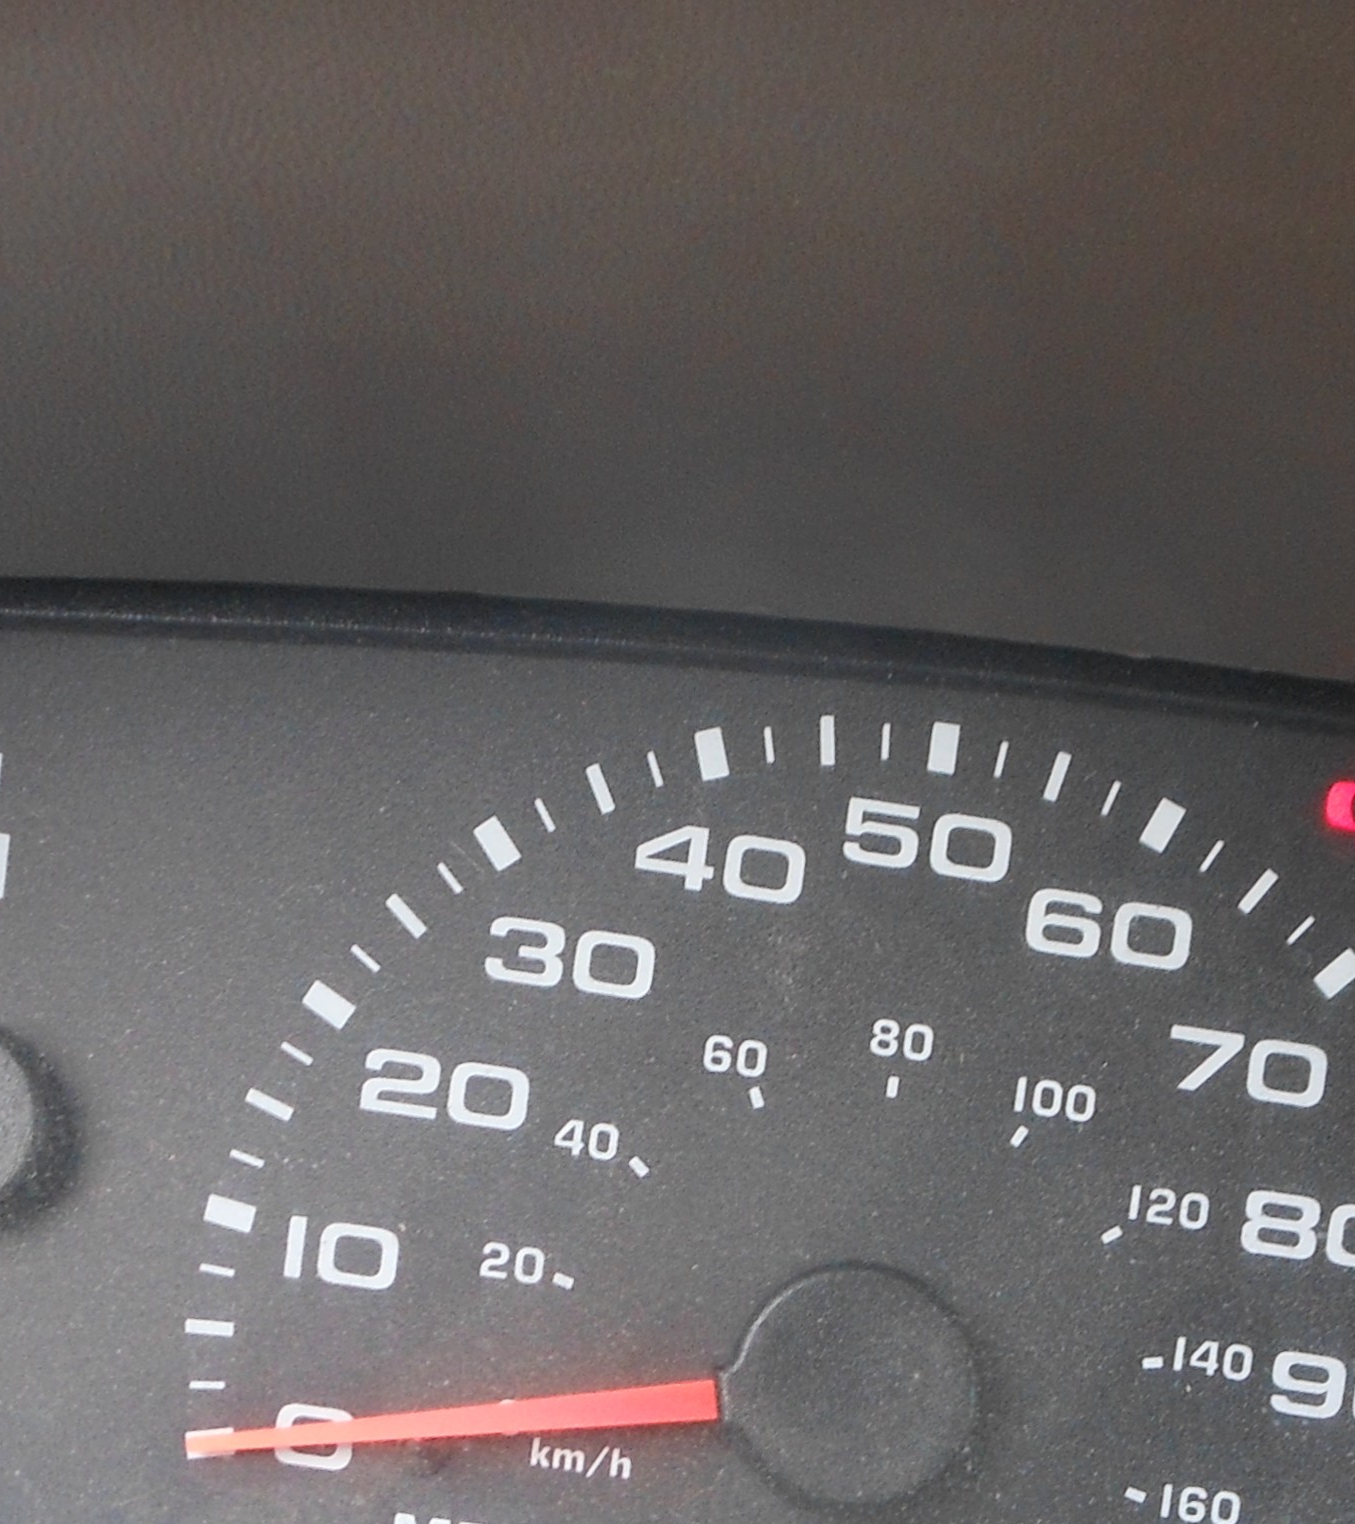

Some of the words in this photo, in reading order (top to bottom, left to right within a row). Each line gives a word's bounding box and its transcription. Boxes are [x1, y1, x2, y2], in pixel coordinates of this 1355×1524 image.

[842, 797, 1013, 883] 50
[634, 825, 806, 904] 40
[1025, 888, 1193, 971] 60
[484, 916, 656, 1000] 30
[703, 1034, 768, 1078] 60
[869, 1018, 934, 1062] 80
[359, 1048, 530, 1131] 20
[1170, 1024, 1328, 1108] 70
[1013, 1076, 1096, 1123] 100
[554, 1119, 620, 1161] 40
[1128, 1184, 1210, 1230] 120
[283, 1215, 400, 1290] 10
[479, 1241, 546, 1284] 20
[1173, 1336, 1253, 1381] 140
[529, 1438, 632, 1481] km/h
